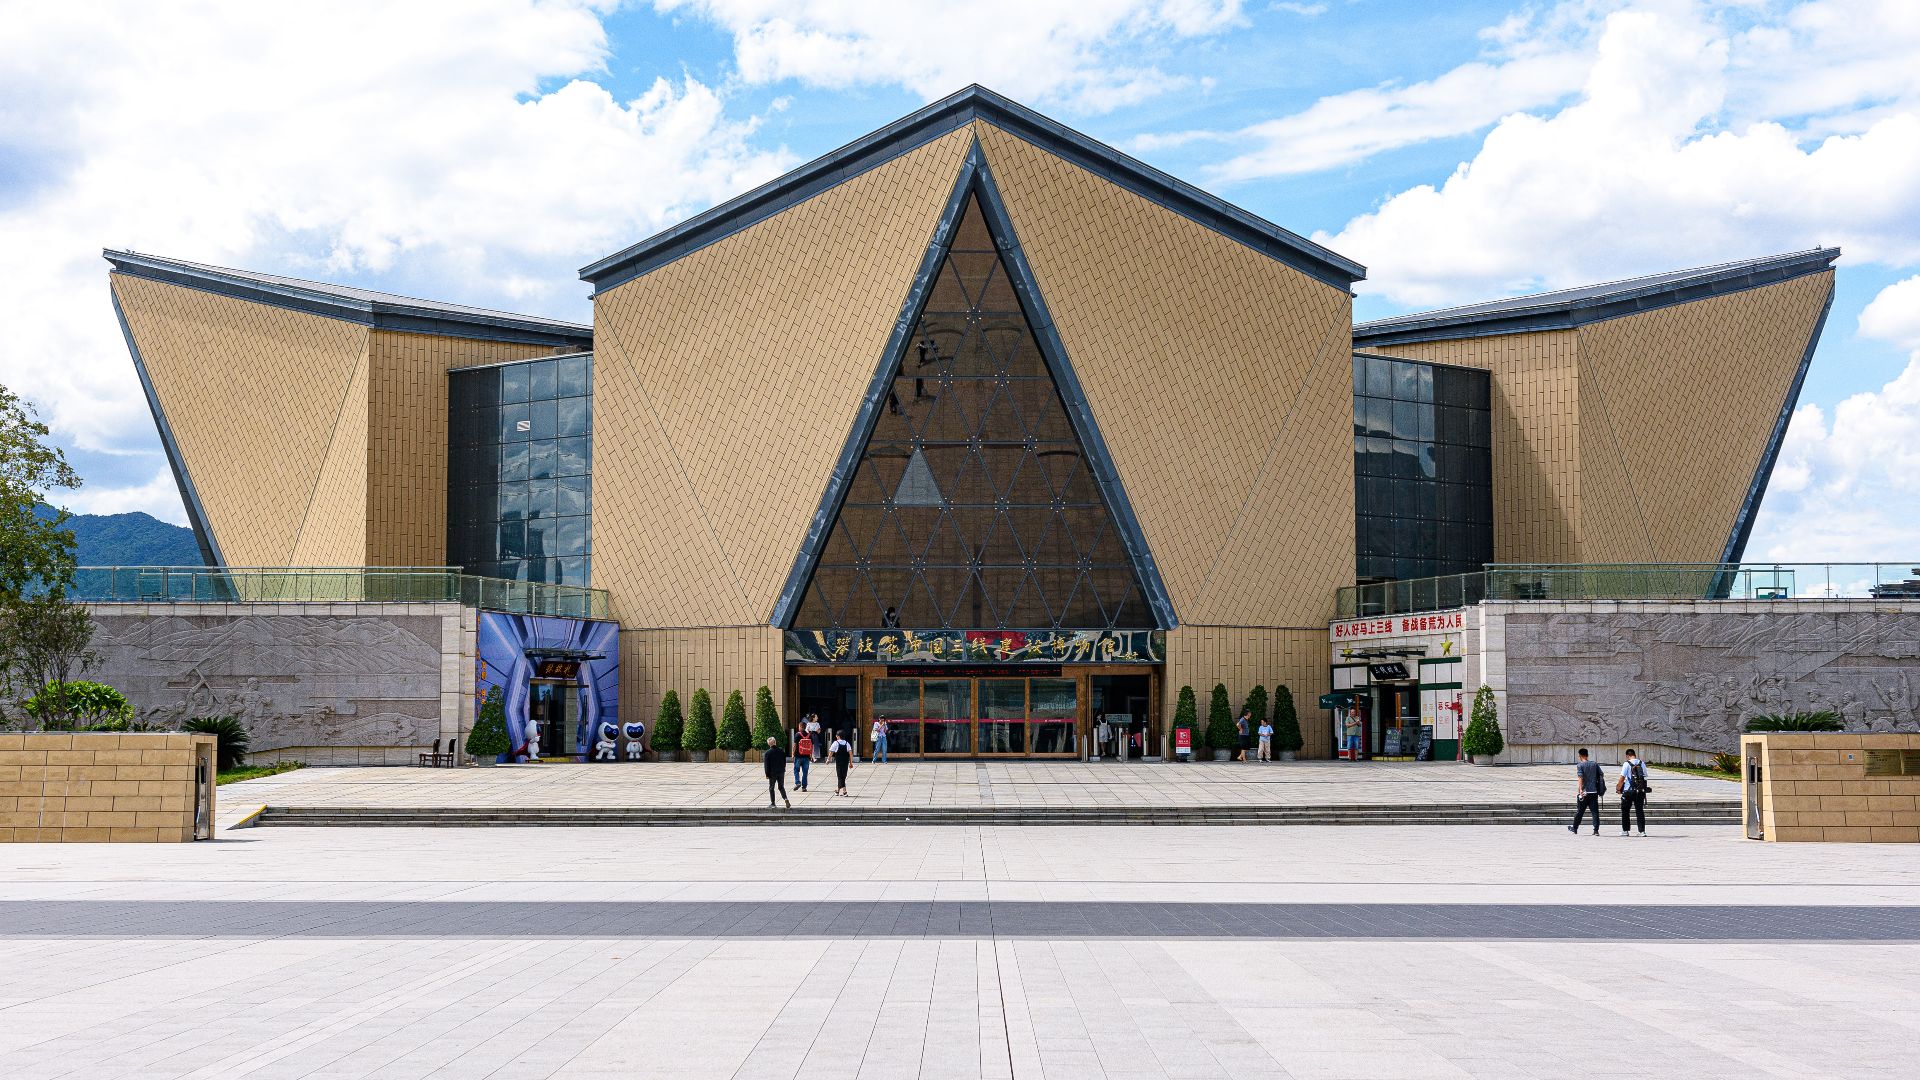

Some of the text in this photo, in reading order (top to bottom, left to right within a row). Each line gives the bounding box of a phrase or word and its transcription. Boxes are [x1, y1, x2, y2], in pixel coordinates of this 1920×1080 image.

[1335, 614, 1462, 637] 好人好马上三线 备战备荒为人民
